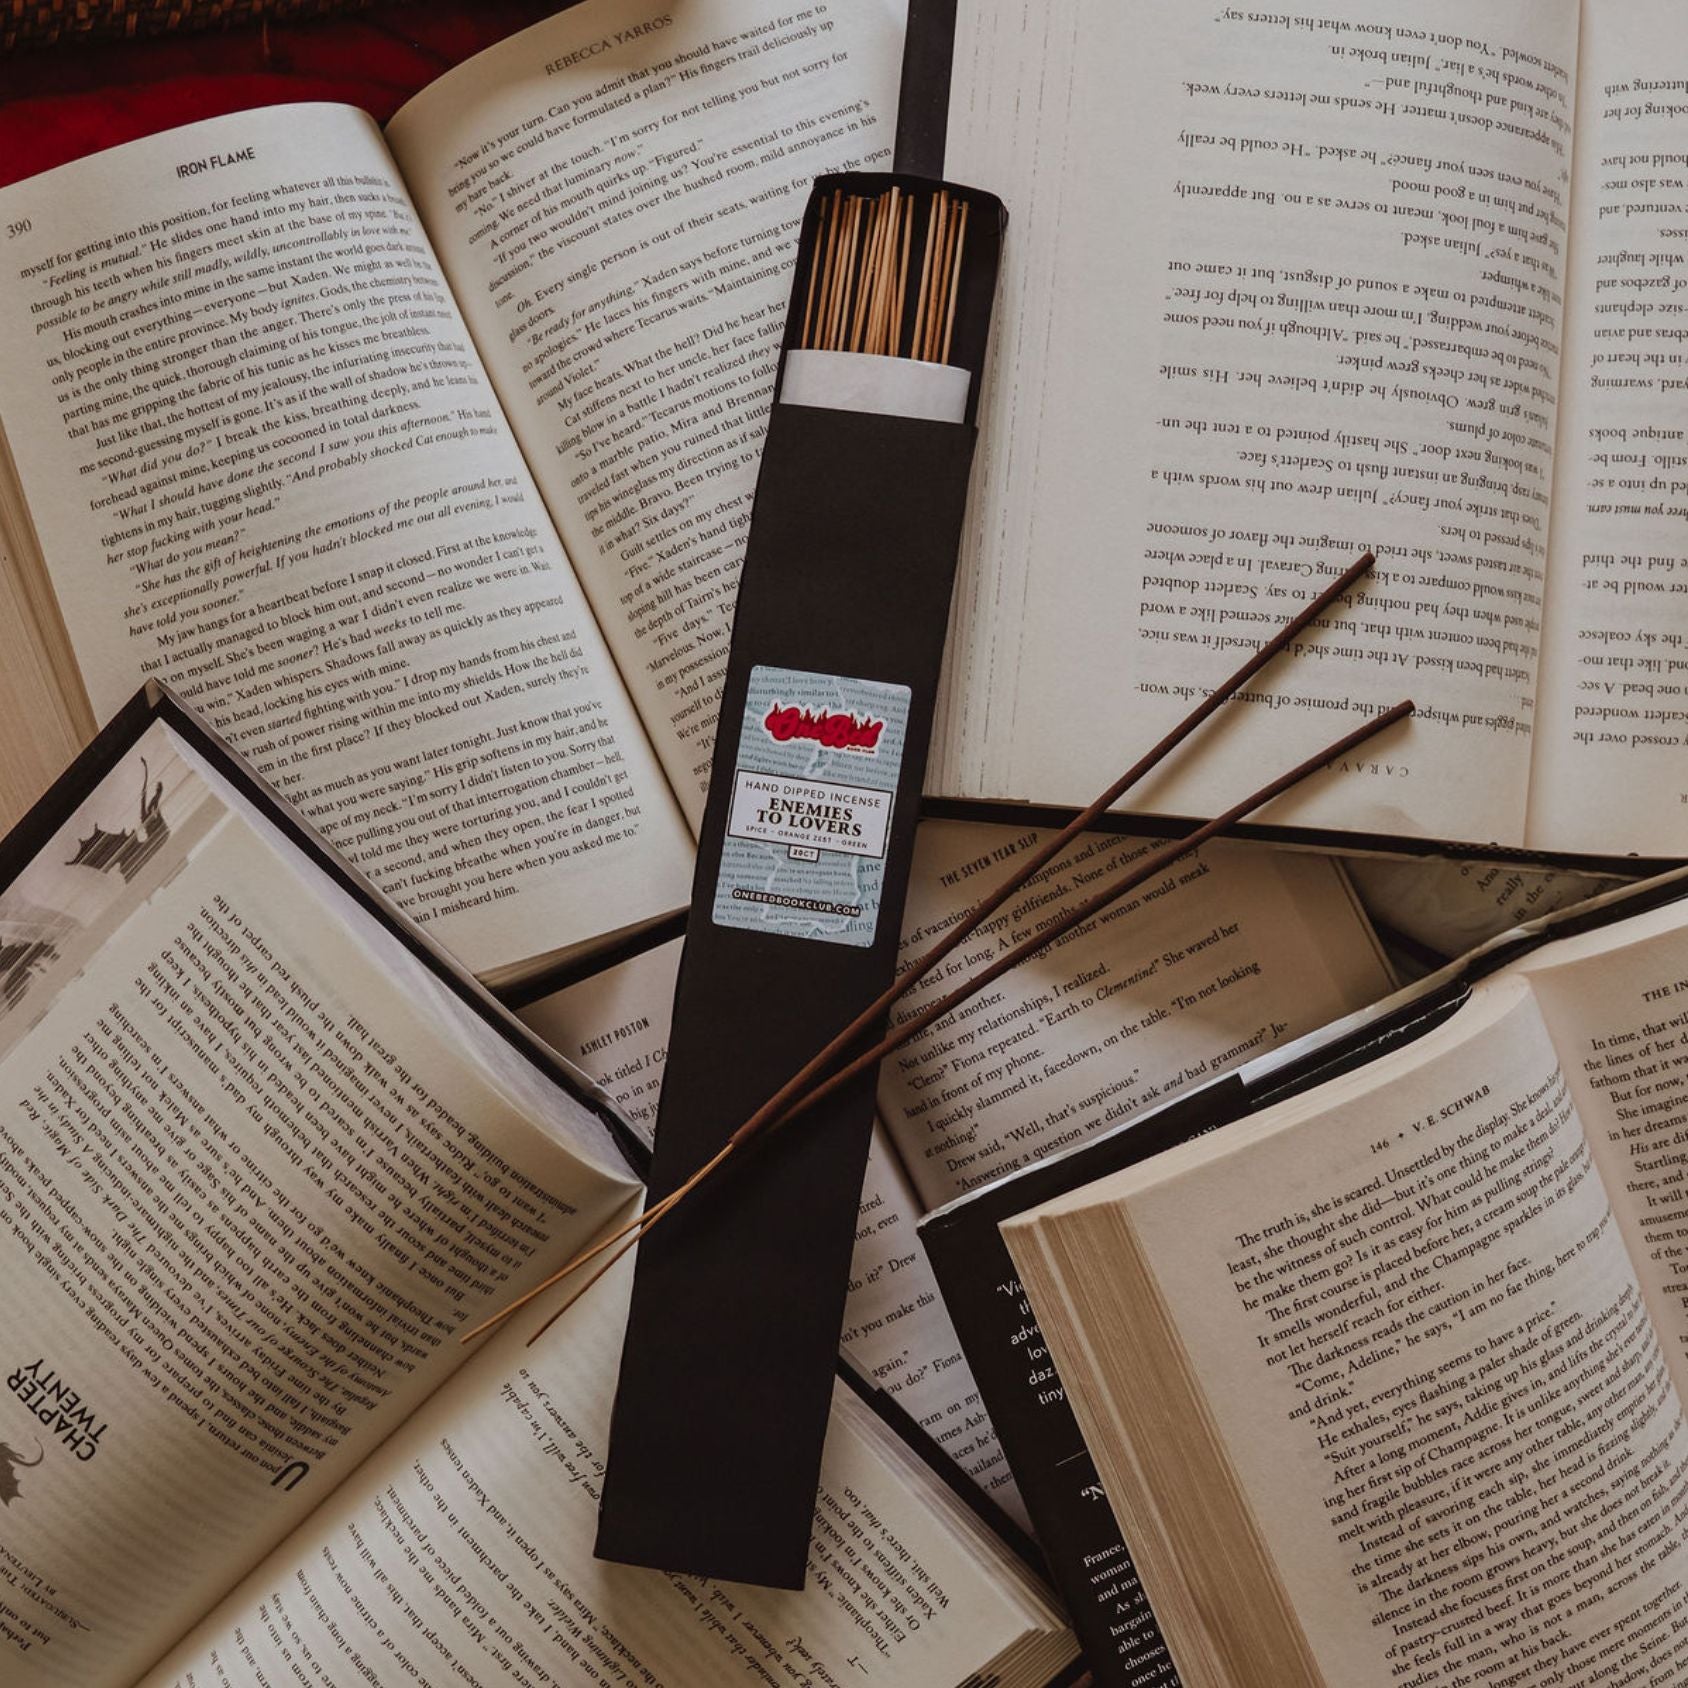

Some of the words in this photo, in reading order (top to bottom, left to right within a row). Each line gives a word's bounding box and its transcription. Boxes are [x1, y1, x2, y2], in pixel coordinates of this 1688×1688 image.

[1247, 13, 1290, 30] letters
[1294, 17, 1314, 31] his
[1318, 19, 1351, 34] what
[1354, 24, 1392, 40] know
[1396, 28, 1427, 40] even
[545, 39, 612, 76] REBECCA
[613, 14, 673, 45] YARROS
[1430, 33, 1463, 50] don’t
[1223, 86, 1261, 97] every
[1264, 90, 1306, 107] letters
[1309, 94, 1330, 104] me
[1334, 97, 1371, 111] sends
[1375, 101, 1395, 116] He
[1450, 111, 1493, 132] doesn’t
[176, 159, 208, 179] IRON
[209, 146, 256, 169] FLAME
[490, 239, 499, 250] A
[499, 220, 529, 244] corner
[531, 210, 543, 224] of
[542, 205, 559, 217] his
[560, 186, 595, 209] mouth
[596, 172, 630, 193] quirks
[7, 219, 32, 240] 390
[89, 485, 138, 511] forehead
[139, 473, 178, 495] against
[179, 464, 211, 480] mine,
[209, 448, 256, 470] keeping
[257, 444, 271, 454] us
[272, 422, 327, 449] cocooned
[328, 421, 341, 431] in
[342, 411, 369, 427] total
[106, 552, 124, 565] her
[126, 544, 148, 558] stop
[151, 530, 191, 553] fucking
[192, 519, 216, 535] with
[218, 512, 243, 528] your
[166, 552, 180, 565] do
[182, 546, 203, 562] you
[129, 622, 154, 637] have
[156, 611, 177, 628] told
[179, 607, 200, 623] you
[745, 780, 779, 793] HAND
[783, 785, 826, 800] DIPPED
[830, 793, 881, 808] INCENSE
[769, 797, 853, 822] ENEMIES
[756, 809, 783, 825] TO
[788, 814, 862, 837] LOVERS
[745, 825, 767, 834] SPICE
[777, 830, 810, 840] ORANGE
[813, 835, 832, 843] ZEST
[841, 839, 868, 849] GREEN
[793, 848, 815, 858] 20CT
[939, 870, 961, 888] THE
[960, 855, 992, 879] SEVEN
[992, 843, 1017, 862] YEAR
[1017, 832, 1038, 850] SLIP
[432, 907, 438, 918] I
[440, 890, 492, 916] misheard
[492, 886, 520, 900] him.
[733, 889, 860, 916] ONEBEDBOOKCLUB.COM
[950, 1051, 986, 1073] Fiona
[987, 1023, 1039, 1056] repeated.
[1081, 997, 1094, 1009] to
[1162, 951, 1186, 967] She
[1185, 929, 1220, 955] waved
[1218, 922, 1239, 938] her
[1641, 986, 1671, 1002] THE
[579, 1033, 613, 1057] ASHLEY
[613, 1017, 650, 1041] POSTON
[367, 1038, 397, 1065] great
[394, 1065, 412, 1085] the
[411, 1083, 429, 1101] for
[1609, 1090, 1633, 1104] But
[1634, 1085, 1651, 1098] for
[1655, 1078, 1684, 1092] now,
[425, 1098, 466, 1138] headed
[1412, 1121, 1425, 1132] V.
[1426, 1115, 1439, 1127] E.
[1439, 1084, 1490, 1120] SCHWAB
[945, 1153, 976, 1172] Drew
[977, 1139, 1005, 1159] said,
[1045, 1103, 1077, 1126] that’s
[1607, 1130, 1621, 1141] in
[1621, 1126, 1641, 1139] her
[1643, 1110, 1687, 1133] dreams
[467, 1132, 510, 1175] building,
[1370, 1139, 1390, 1154] 146
[1265, 1351, 1288, 1366] not
[1288, 1342, 1306, 1357] let
[1306, 1319, 1350, 1348] herself
[1351, 1306, 1385, 1329] reach
[1387, 1298, 1404, 1313] for
[1407, 1281, 1445, 1304] either.
[1287, 1361, 1314, 1376] The
[1315, 1337, 1370, 1366] darkness
[1371, 1319, 1404, 1342] reads
[1405, 1311, 1425, 1326] the
[1428, 1289, 1471, 1316] caution
[1471, 1282, 1485, 1294] in
[1485, 1270, 1505, 1286] her
[1506, 1257, 1531, 1275] face.
[1345, 1401, 1370, 1420] yet,
[1371, 1370, 1437, 1405] everything
[1437, 1352, 1473, 1375] seems
[1474, 1345, 1487, 1356] to
[1487, 1330, 1515, 1350] have
[1517, 1325, 1524, 1335] a
[24, 1359, 108, 1444] TWENTY
[1038, 1387, 1063, 1405] tiny
[7, 1368, 96, 1461] CHAPTER
[1288, 1400, 1312, 1420] and
[860, 1504, 882, 1529] that,
[880, 1528, 911, 1562] there’s
[1083, 1544, 1125, 1567] France,
[911, 1560, 929, 1583] shit,
[1090, 1560, 1131, 1584] woman
[926, 1582, 950, 1609] Well
[1109, 1611, 1152, 1636] bargain
[1118, 1636, 1140, 1654] able
[1142, 1630, 1154, 1641] to
